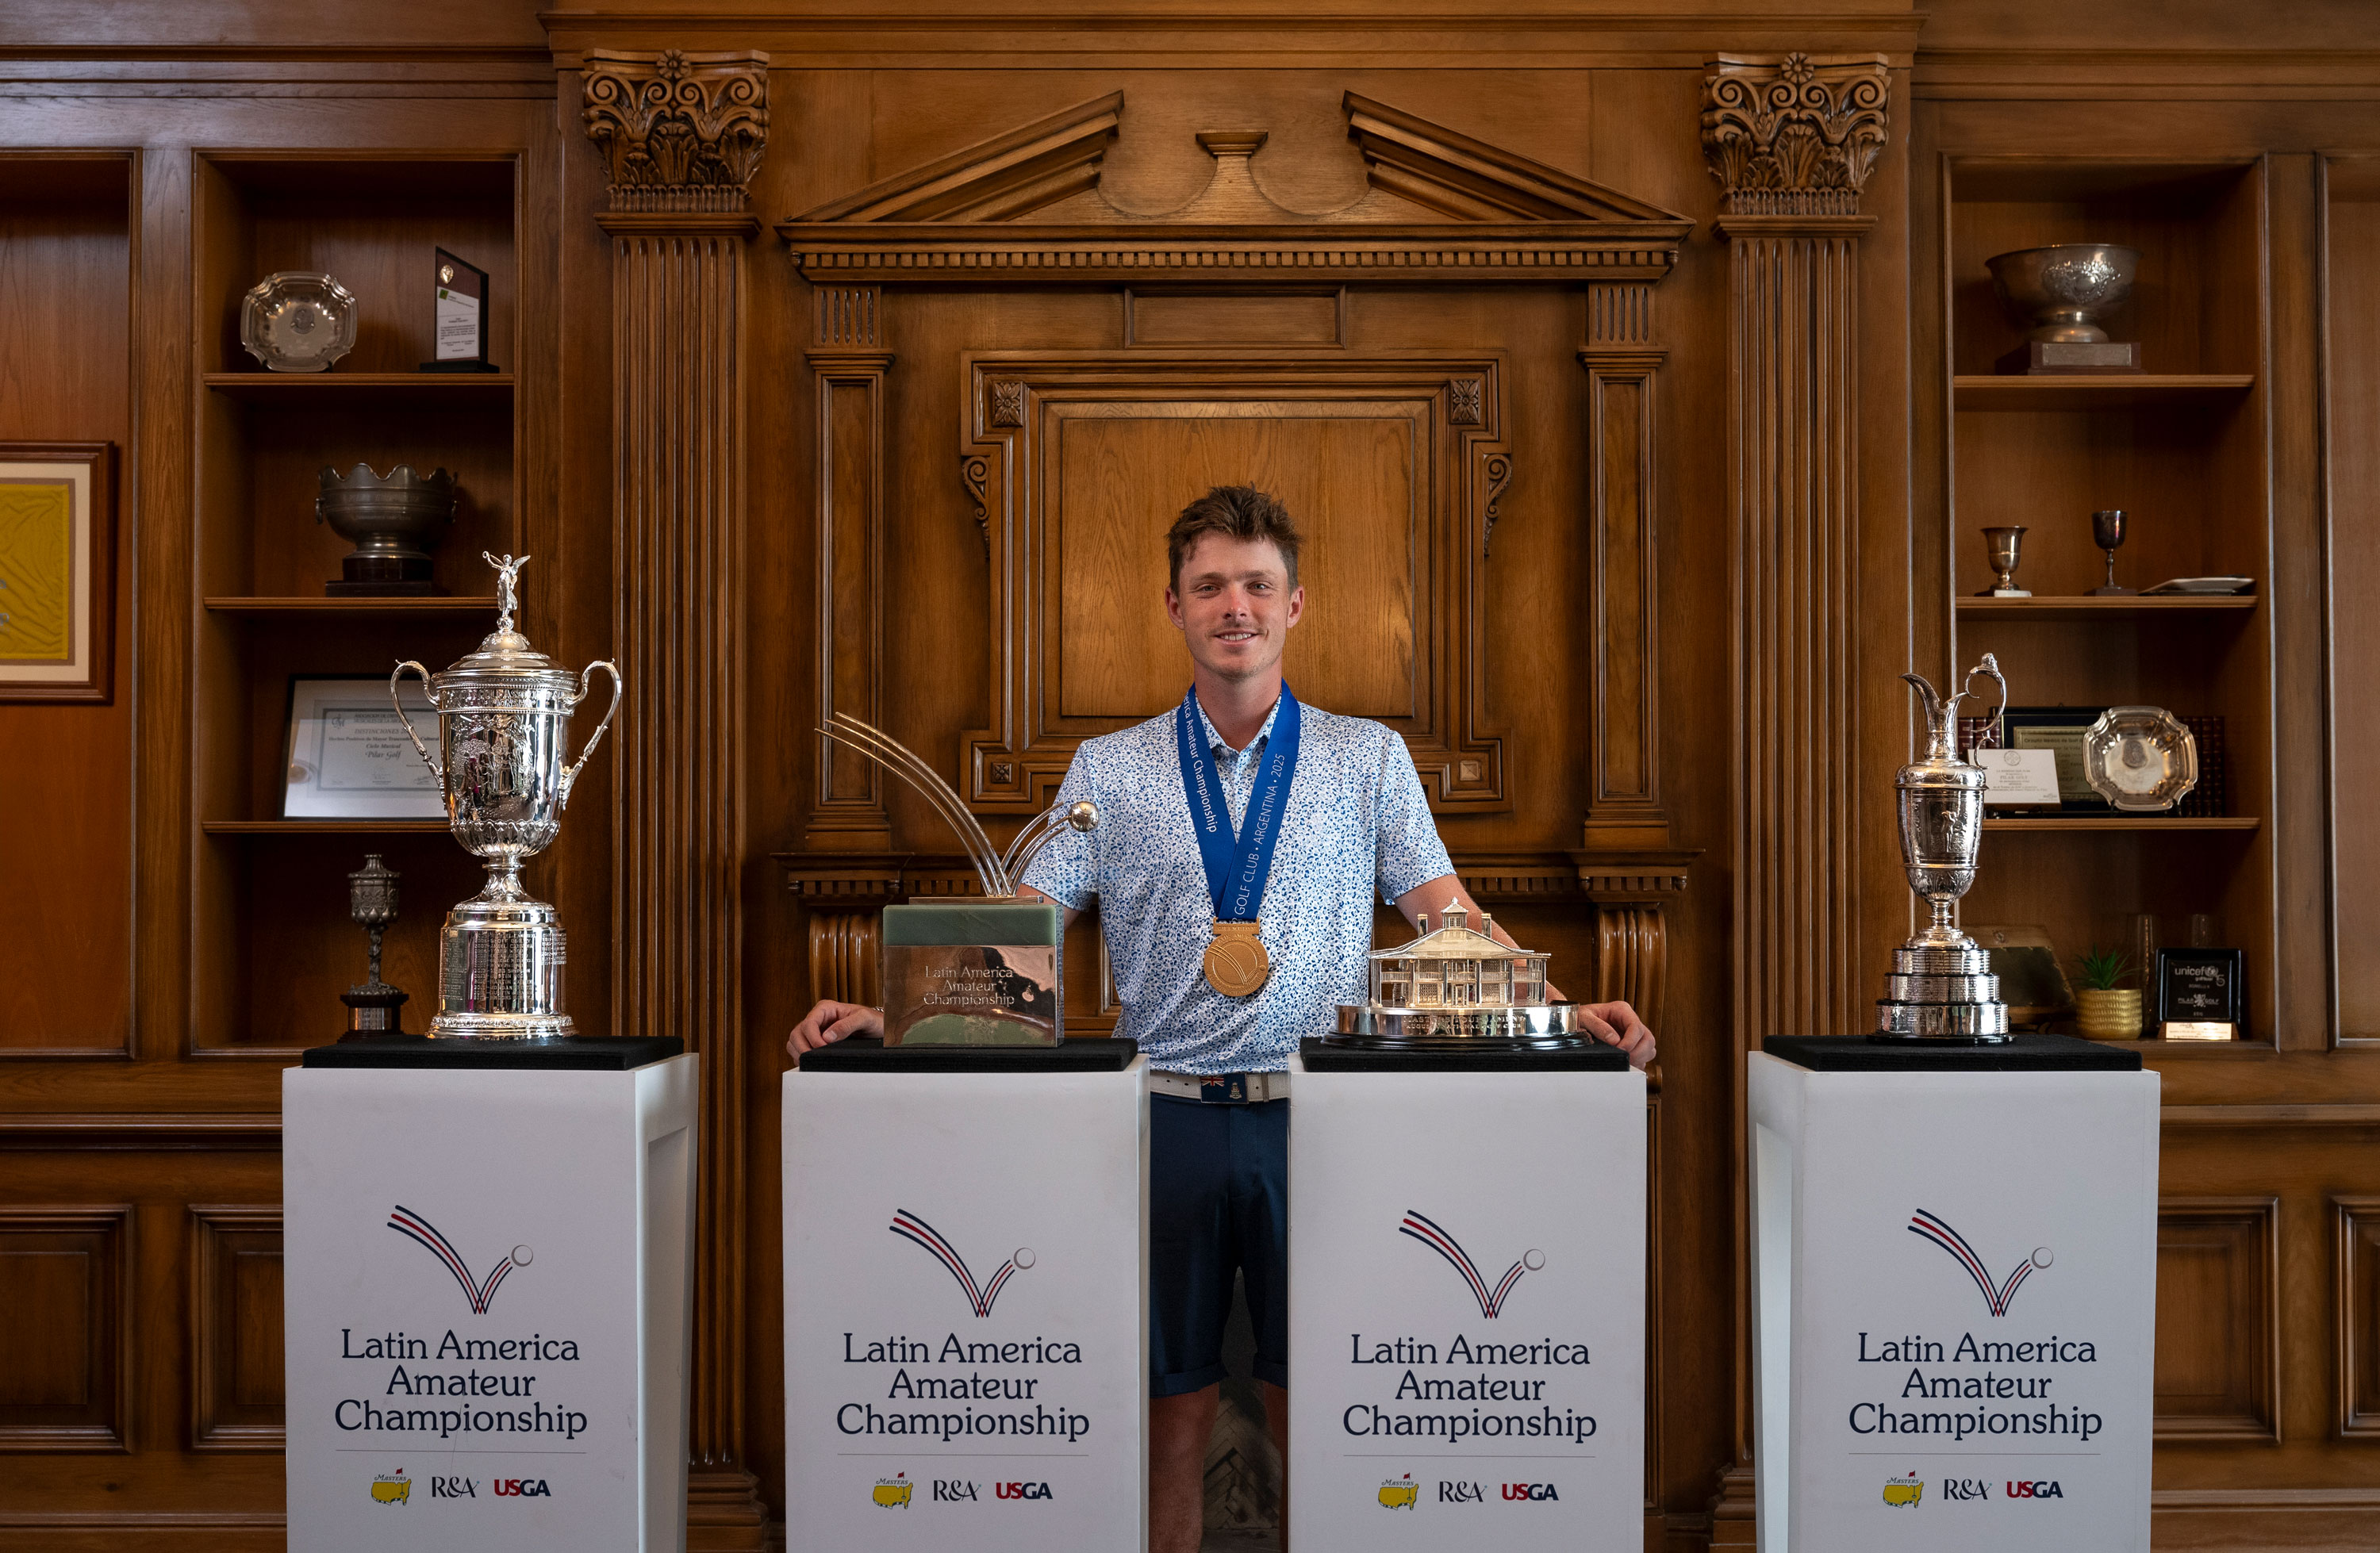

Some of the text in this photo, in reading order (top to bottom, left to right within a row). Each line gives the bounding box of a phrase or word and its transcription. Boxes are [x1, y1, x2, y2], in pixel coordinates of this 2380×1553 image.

[1186, 719, 1199, 758] Amateur
[1192, 760, 1218, 833] Championship
[1234, 753, 1285, 915] GOLF CLUB ARGENTINA 2025
[925, 965, 1014, 978] Latin America
[942, 980, 996, 991] Amateur
[2175, 965, 2205, 976] unicef
[923, 992, 1015, 1007] Championship
[342, 1329, 580, 1360] Latin America
[843, 1333, 1082, 1363] Latin America
[1351, 1334, 1590, 1365] Latin America
[1858, 1333, 2097, 1363] Latin America
[386, 1364, 536, 1396] Amateur
[889, 1368, 1038, 1399] Amateur
[1395, 1370, 1545, 1401] Amateur
[1902, 1367, 2052, 1398] Amateur
[335, 1399, 587, 1440] Championship
[837, 1403, 1089, 1442] Championship
[1343, 1405, 1596, 1444] Championship
[1849, 1403, 2102, 1441] Championship
[432, 1477, 479, 1497] R&A
[493, 1479, 551, 1497] USGA
[934, 1480, 981, 1501] R&A
[996, 1482, 1054, 1500] USGA
[1439, 1482, 1487, 1502] R&A
[1502, 1483, 1559, 1501] USGA
[1944, 1479, 1992, 1500] R&A
[2006, 1481, 2064, 1499] USGA
